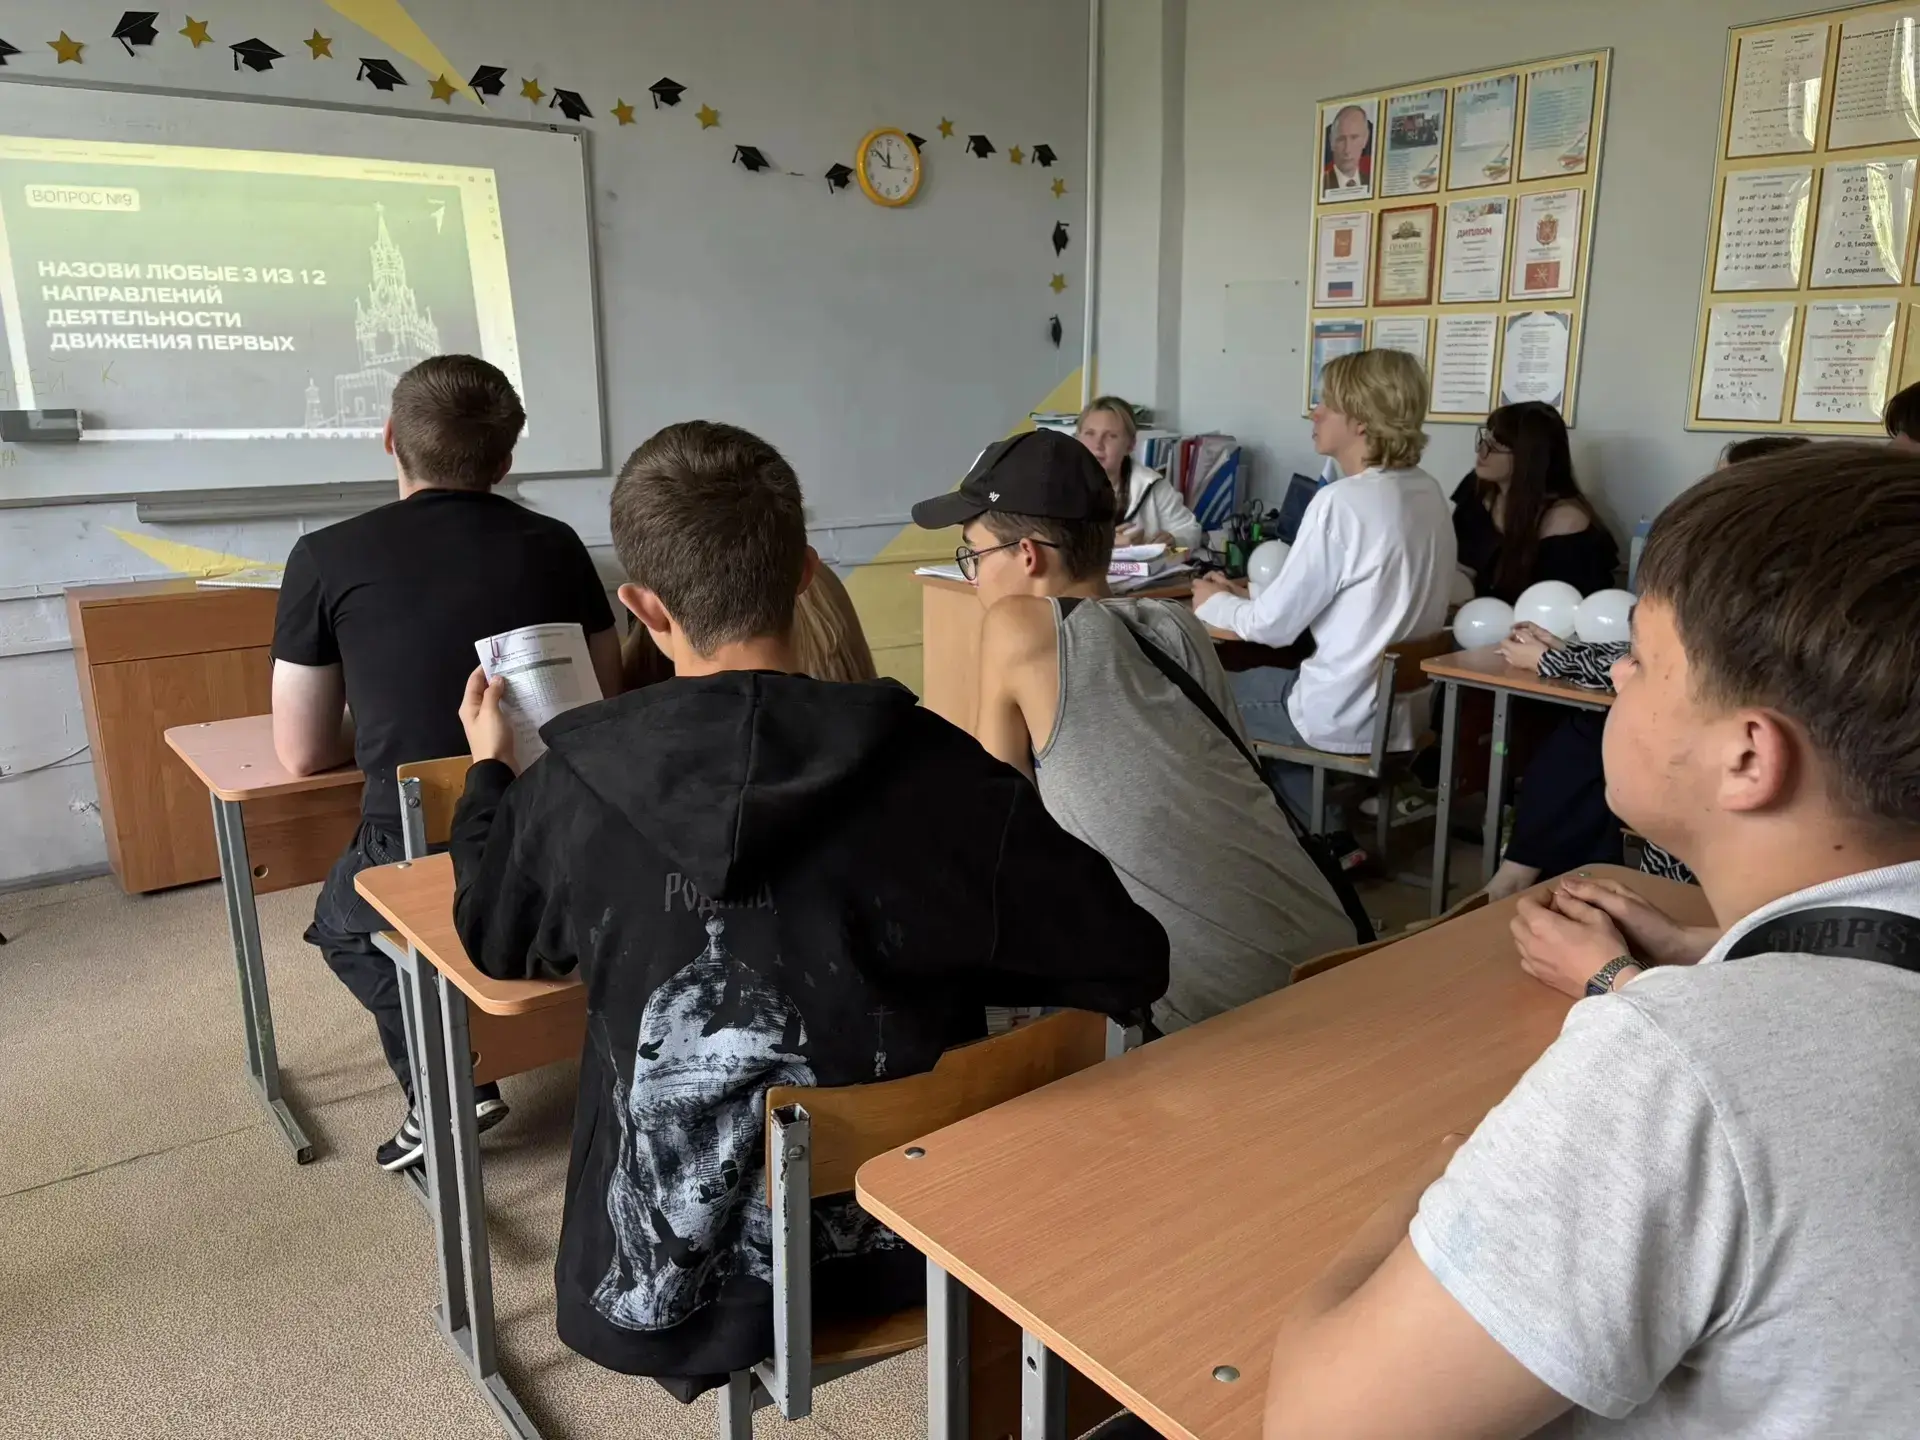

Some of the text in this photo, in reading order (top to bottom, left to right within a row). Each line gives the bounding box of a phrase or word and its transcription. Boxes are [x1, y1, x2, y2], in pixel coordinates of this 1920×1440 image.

[32, 189, 132, 207] ВОПРОС №9
[1457, 227, 1492, 239] ДИПЛОМ
[37, 260, 327, 286] НАЗОВИ ЛЮБЫЕ 3 ИЗ 12
[41, 283, 224, 304] НАПРАВЛЕНИЙ
[46, 308, 242, 328] ДЕЯТЕЛЬНОСТИ
[50, 332, 296, 352] ДВИЖЕНИЯ ПЕРВЫХ
[664, 872, 775, 920] РОДА
